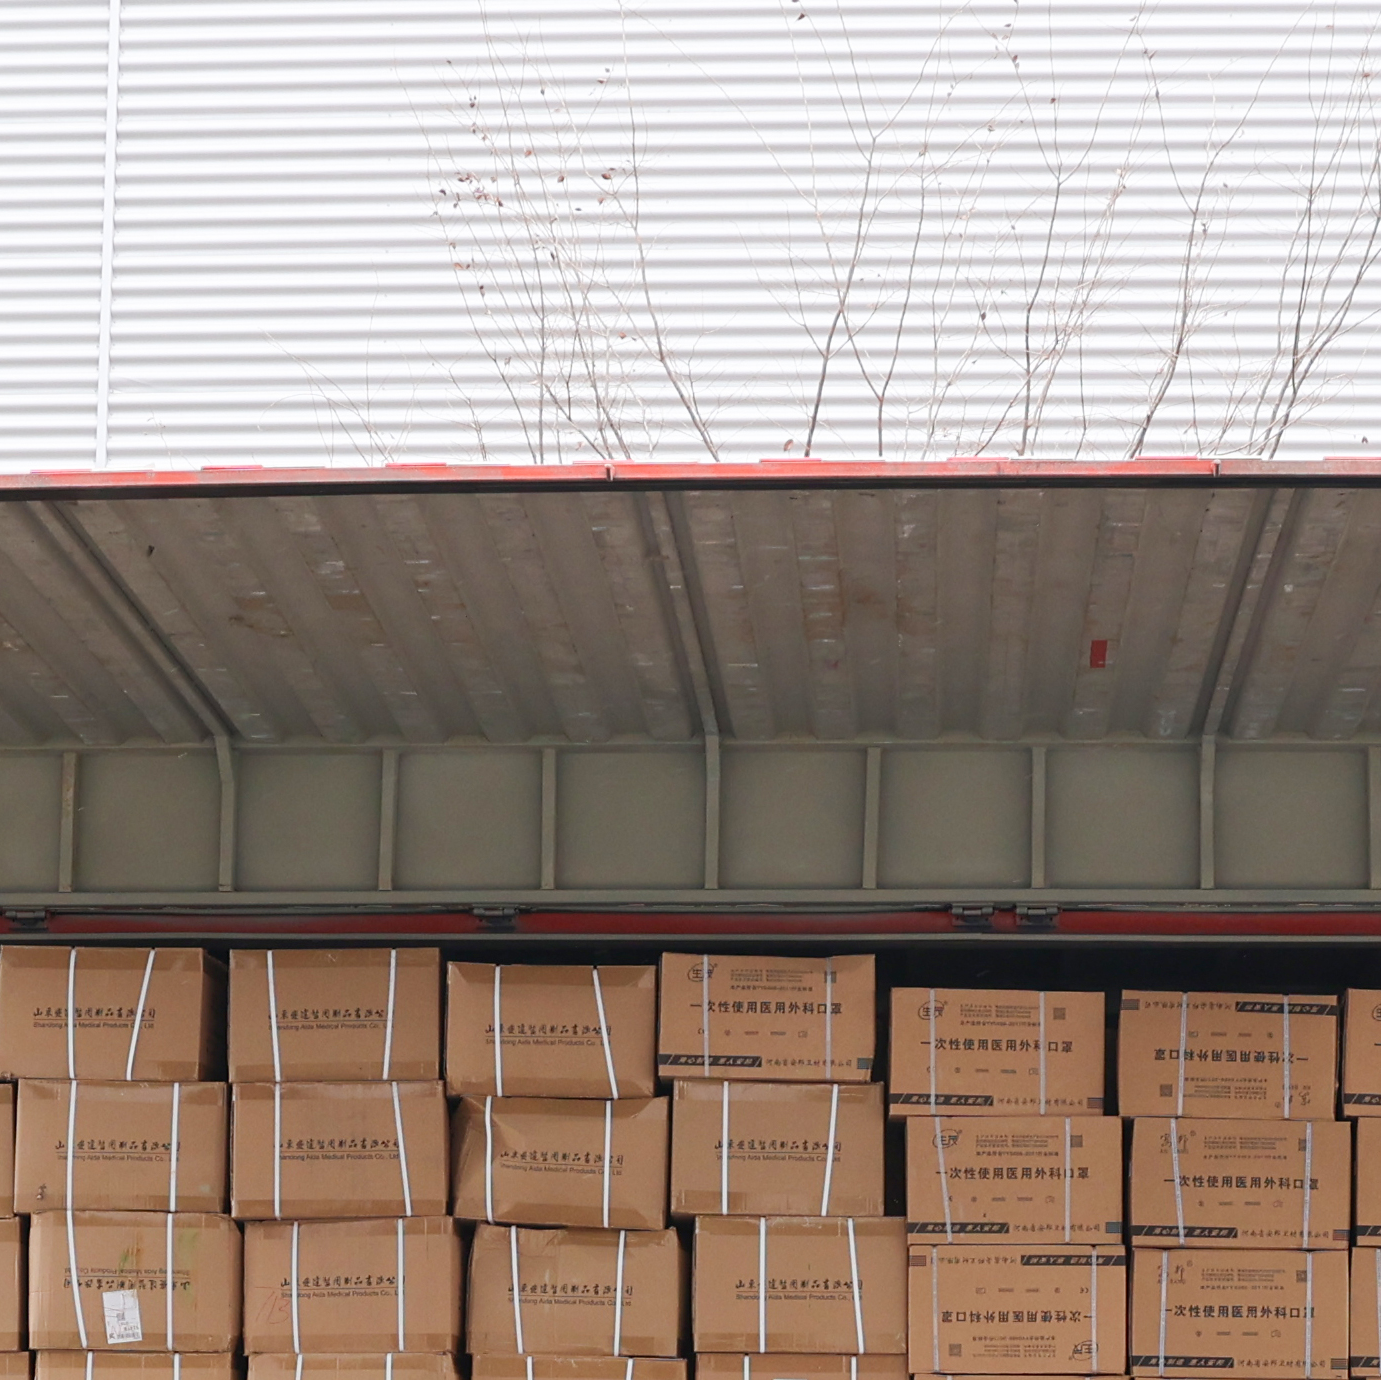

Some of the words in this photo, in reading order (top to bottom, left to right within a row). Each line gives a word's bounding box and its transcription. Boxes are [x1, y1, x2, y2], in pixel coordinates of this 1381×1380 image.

[689, 999, 841, 1015] 一次性使用医用外科口罩
[1163, 1174, 1318, 1190] 一次性使用医用外科口罩
[941, 1310, 1095, 1322] 一次性使用医用外科口罩
